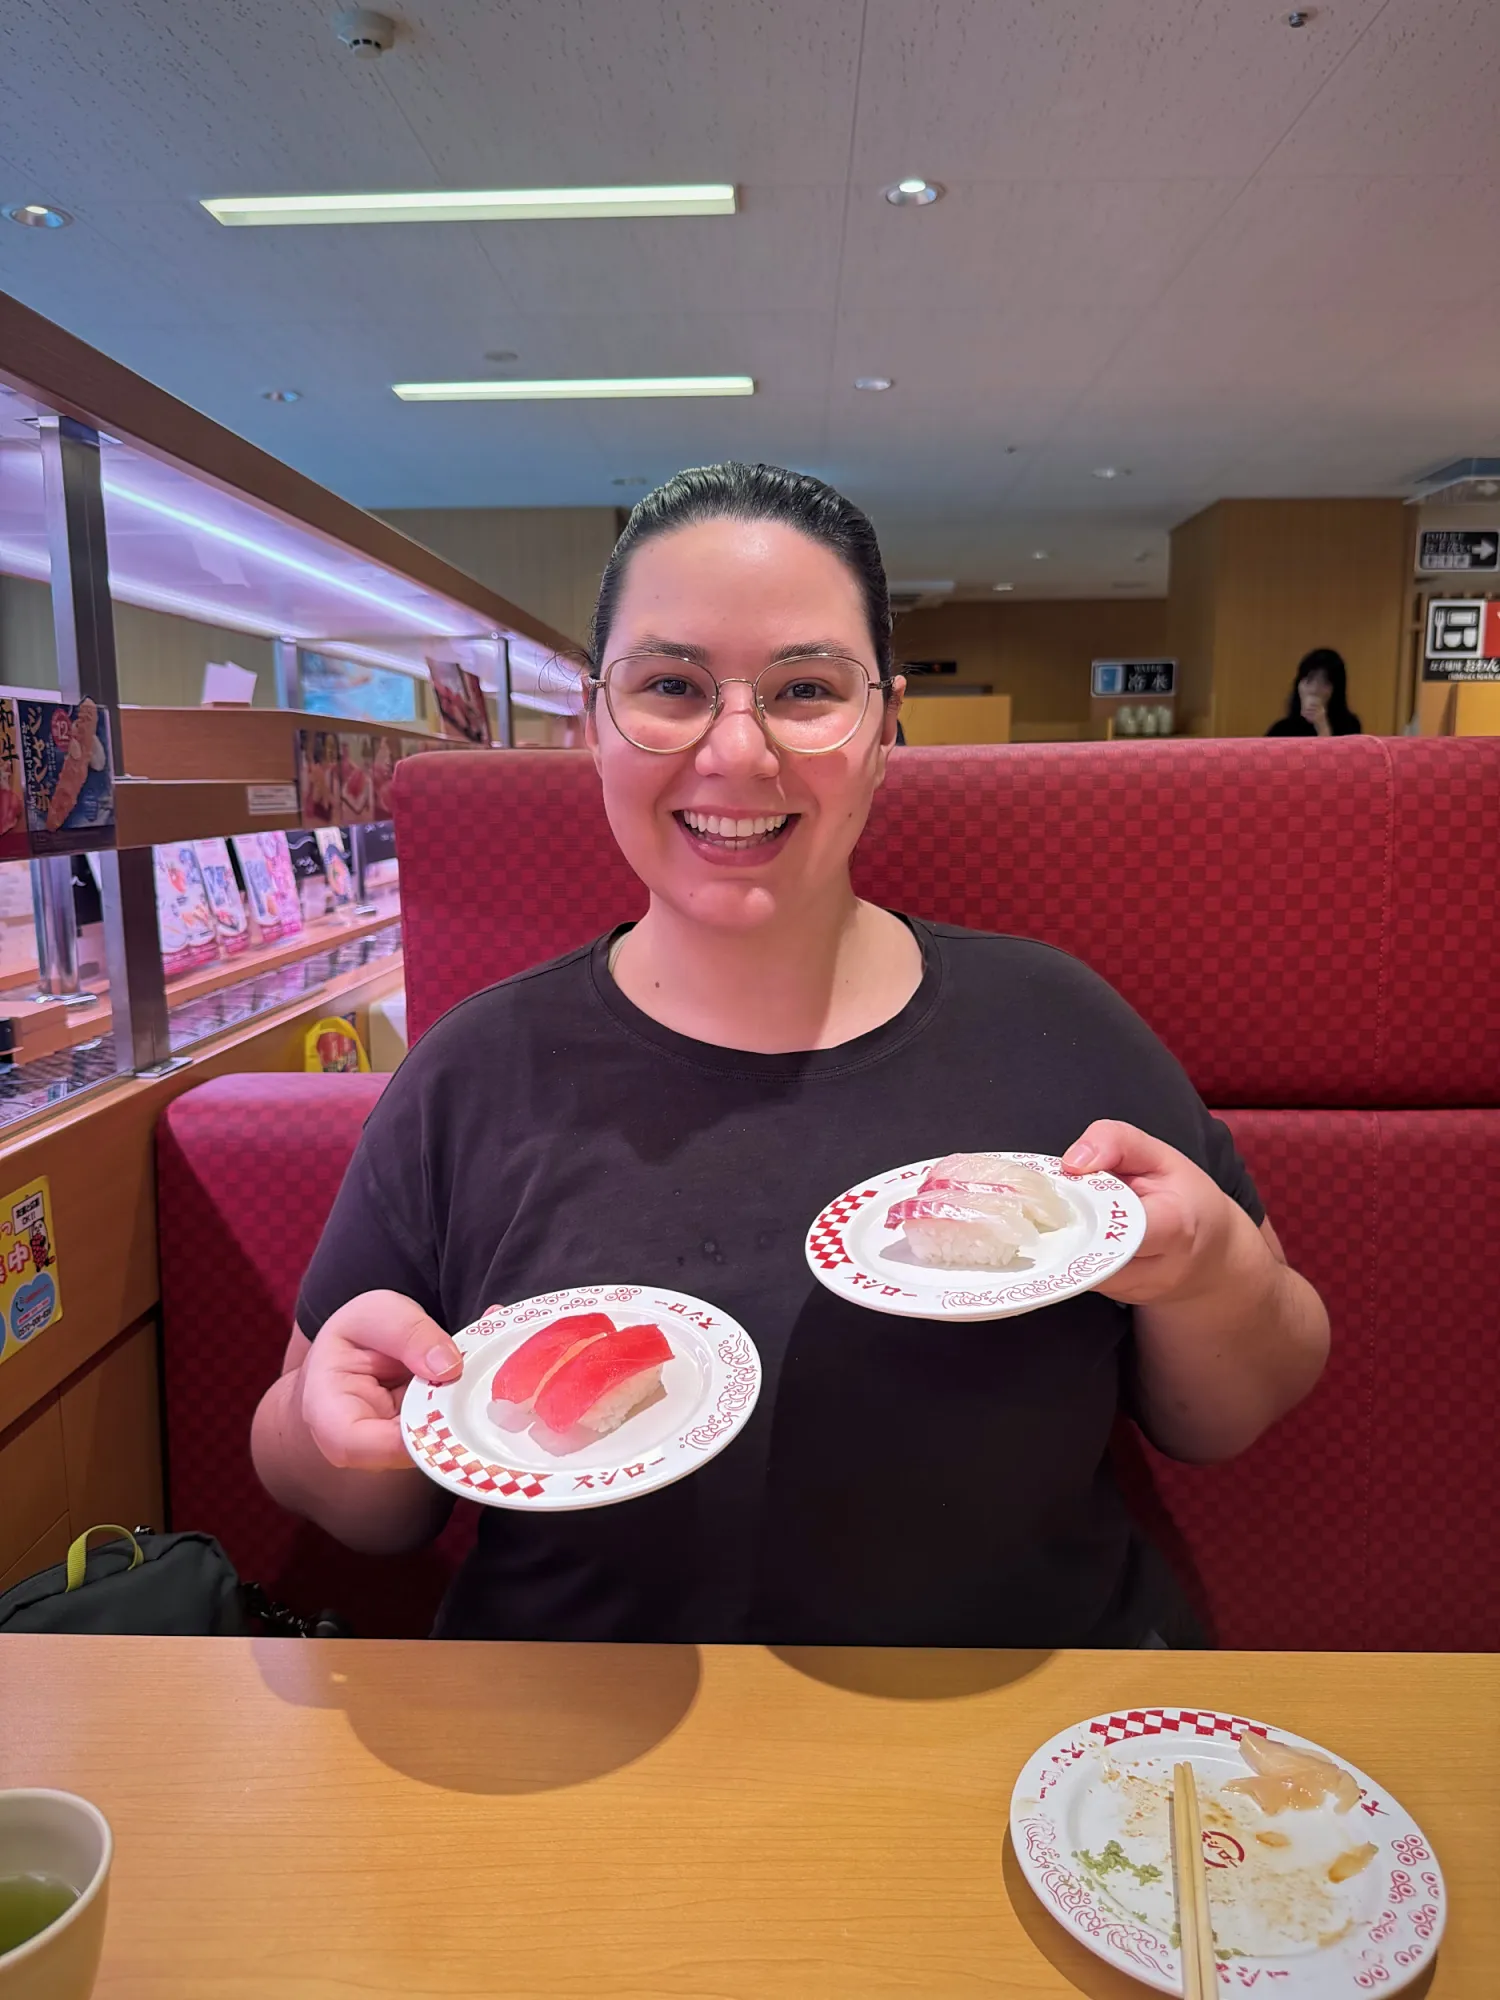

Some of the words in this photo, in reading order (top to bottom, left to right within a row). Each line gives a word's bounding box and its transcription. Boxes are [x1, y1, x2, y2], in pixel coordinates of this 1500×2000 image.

[56, 721, 69, 741] 12
[27, 706, 51, 812] ジャンボ
[1104, 1200, 1129, 1243] スシロー
[843, 1271, 918, 1298] スシロー
[654, 1299, 721, 1331] スシロー
[571, 1456, 666, 1491] スシロー
